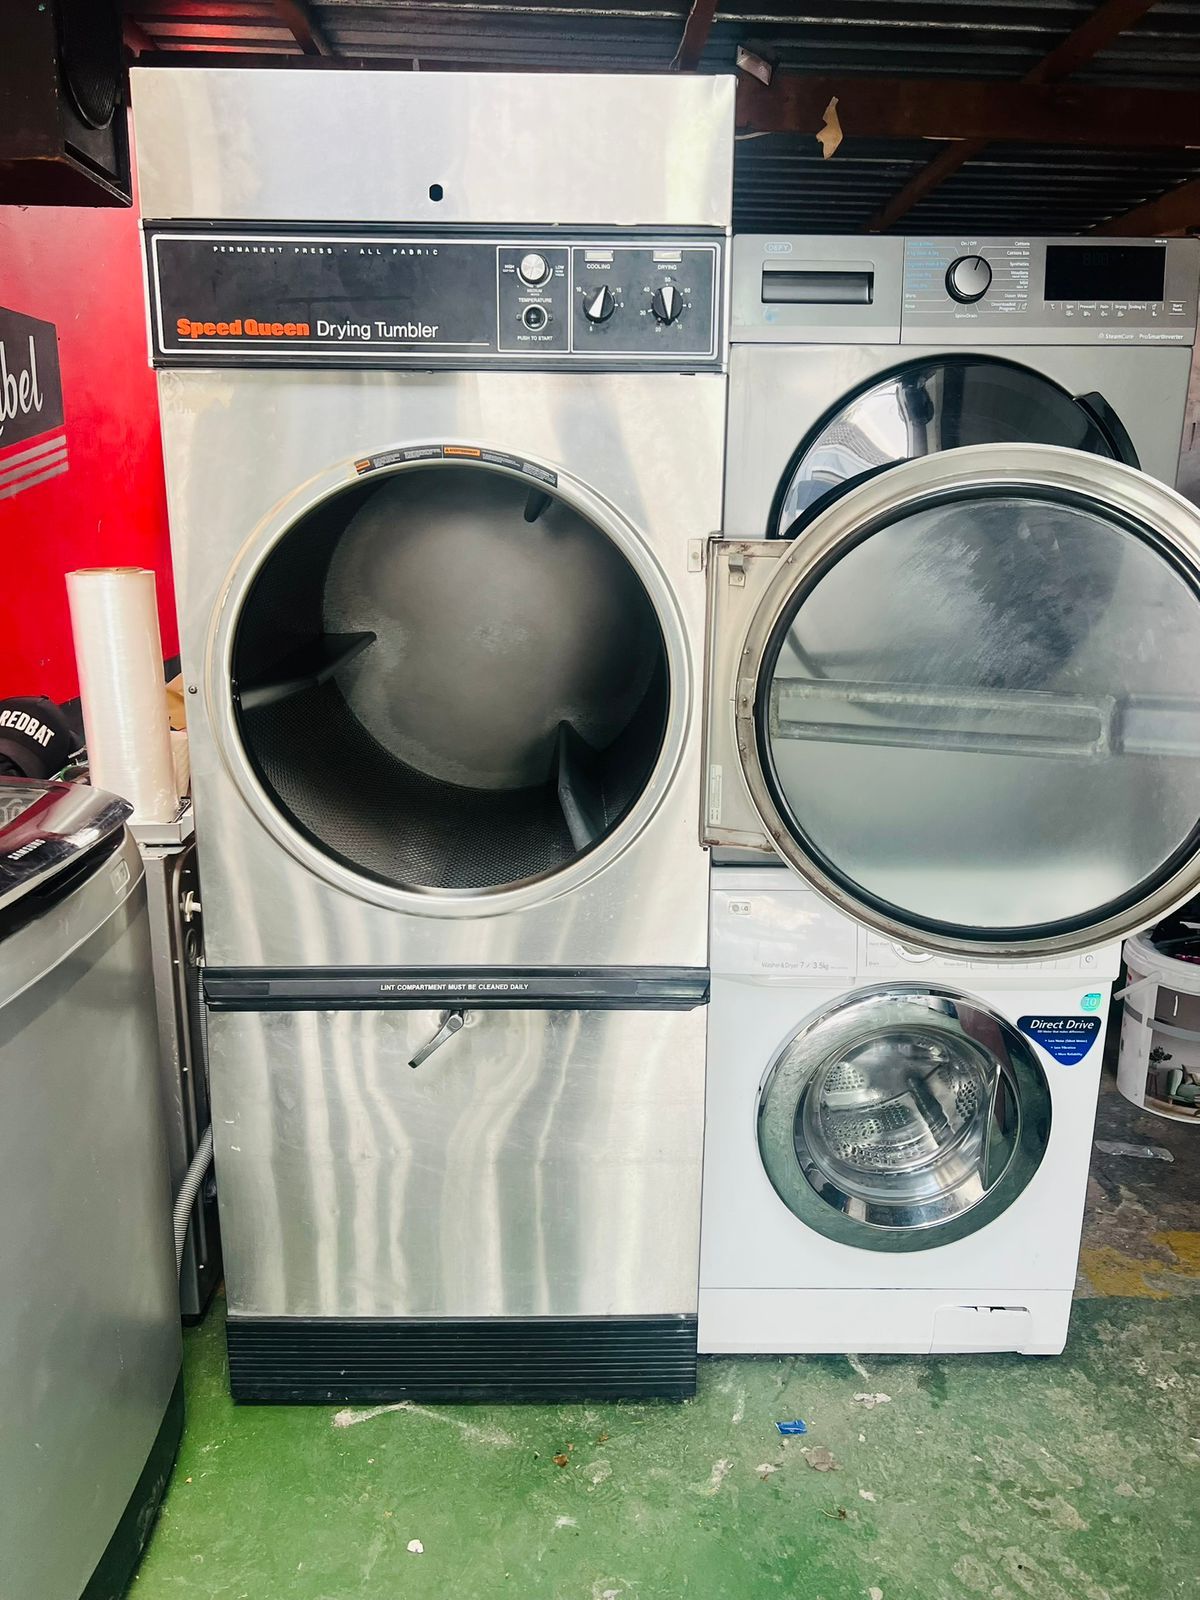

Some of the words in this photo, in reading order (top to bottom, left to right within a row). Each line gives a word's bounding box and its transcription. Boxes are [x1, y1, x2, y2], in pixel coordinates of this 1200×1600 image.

[176, 318, 242, 338] Speed
[244, 319, 310, 337] Queen
[316, 320, 371, 340] Drying
[374, 321, 439, 338] Tumbler
[0, 335, 43, 421] bel
[0, 710, 55, 748] REDBAT
[7, 838, 46, 861] SAMSUNG
[1030, 1019, 1064, 1029] Direct
[1066, 1019, 1095, 1029] Drive
